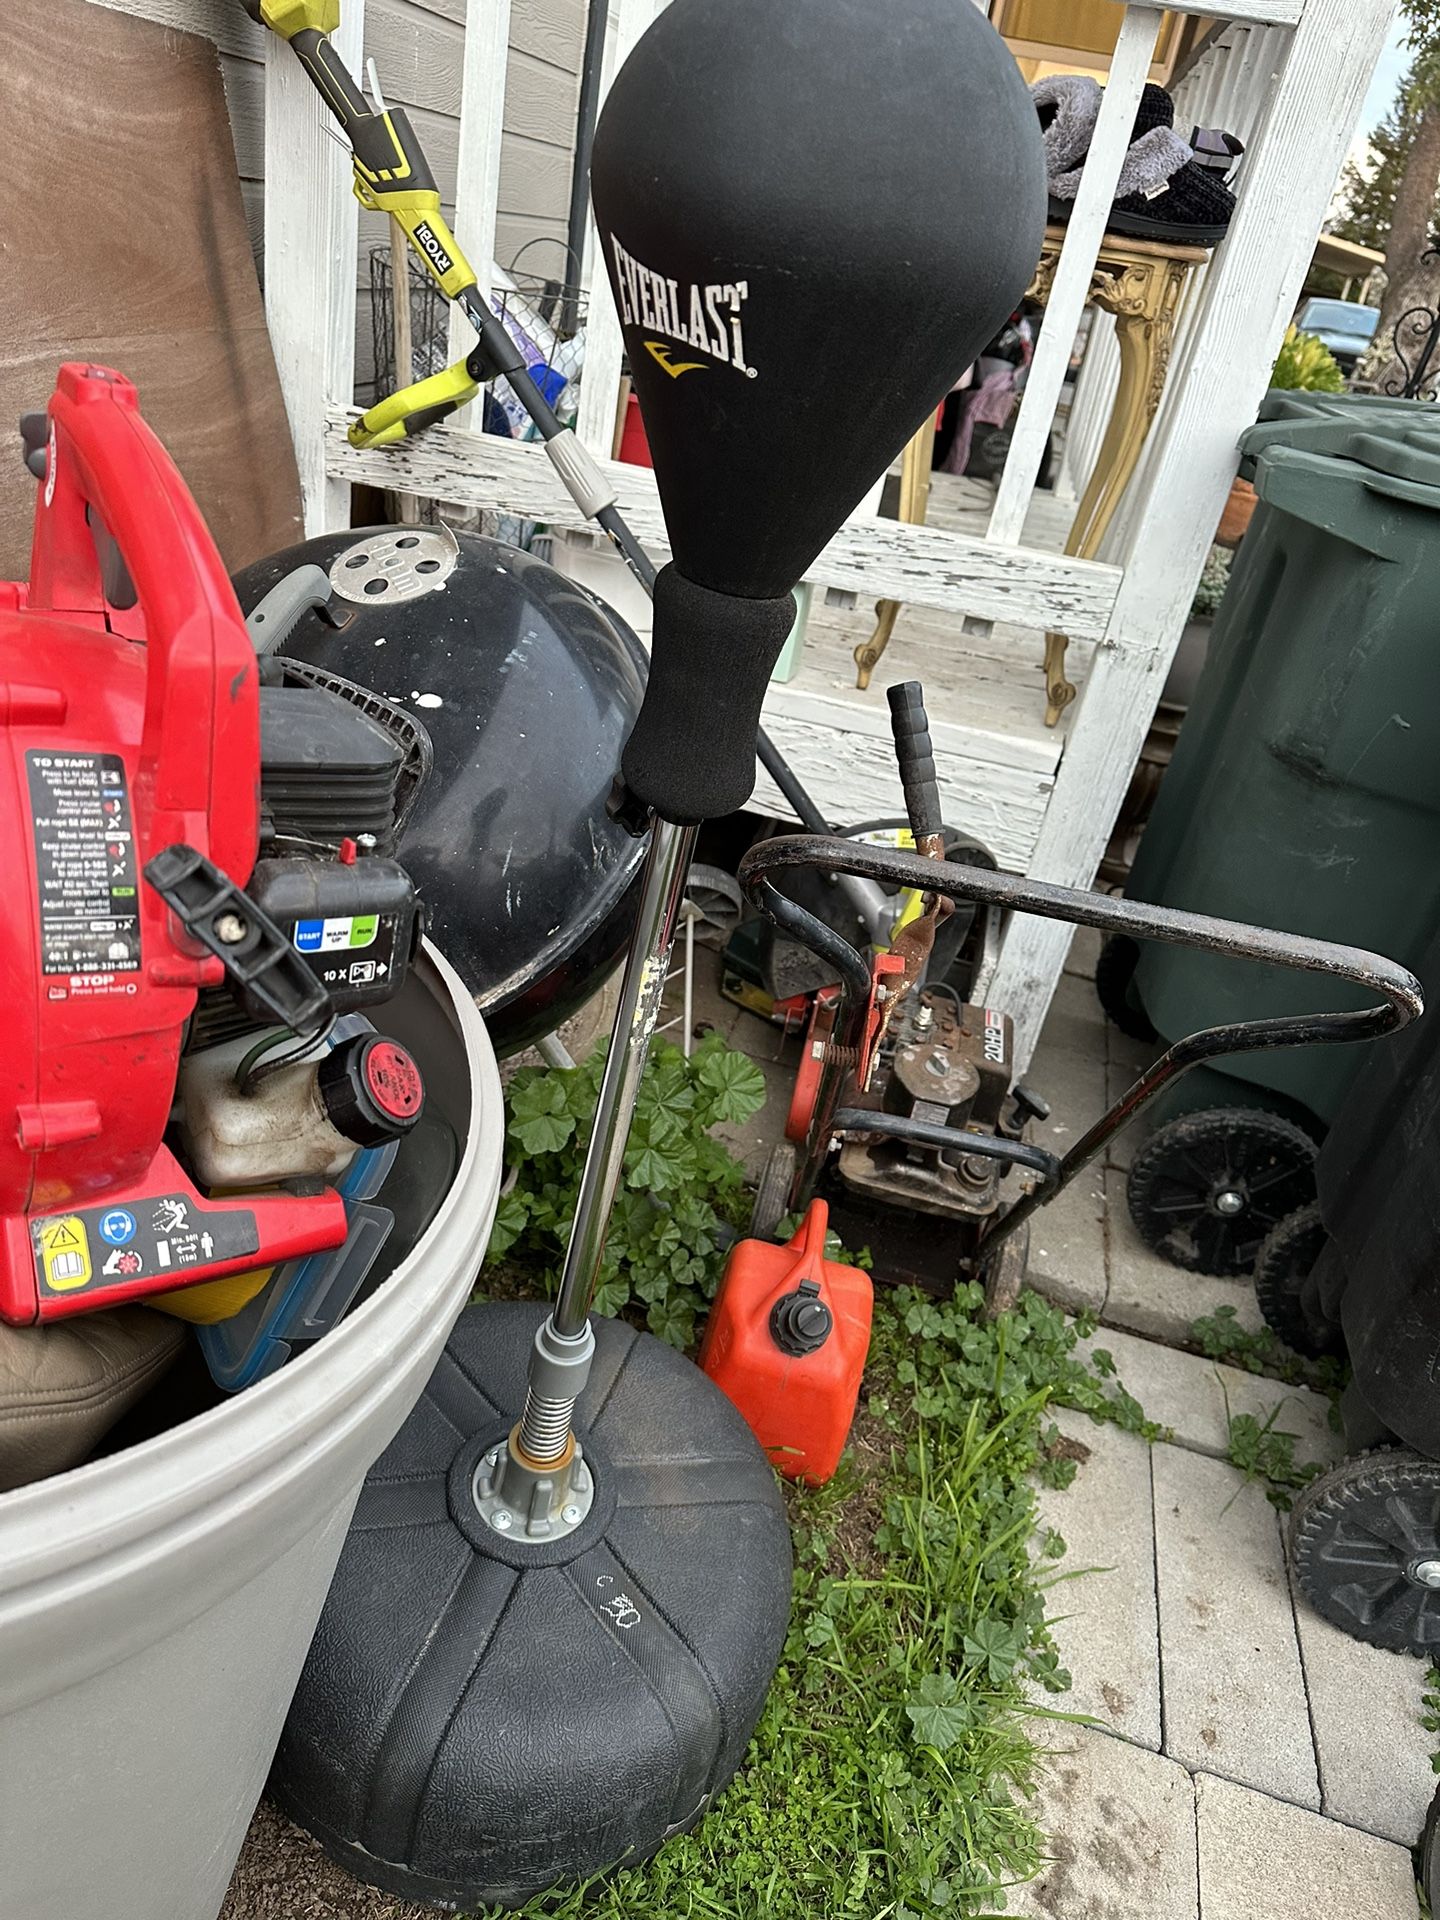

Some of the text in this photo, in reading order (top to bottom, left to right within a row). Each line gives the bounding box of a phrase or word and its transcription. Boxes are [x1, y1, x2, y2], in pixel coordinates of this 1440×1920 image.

[415, 222, 451, 273] RYOBI
[610, 231, 750, 373] EVERLAST
[32, 757, 95, 768] TO START
[53, 788, 72, 797] Move
[73, 789, 90, 797] lever
[91, 789, 100, 797] to
[36, 817, 50, 826] Pull
[57, 830, 77, 839] Move
[298, 928, 372, 941] START WARM RUN
[69, 974, 115, 987] STOP
[323, 968, 347, 981] 10 X
